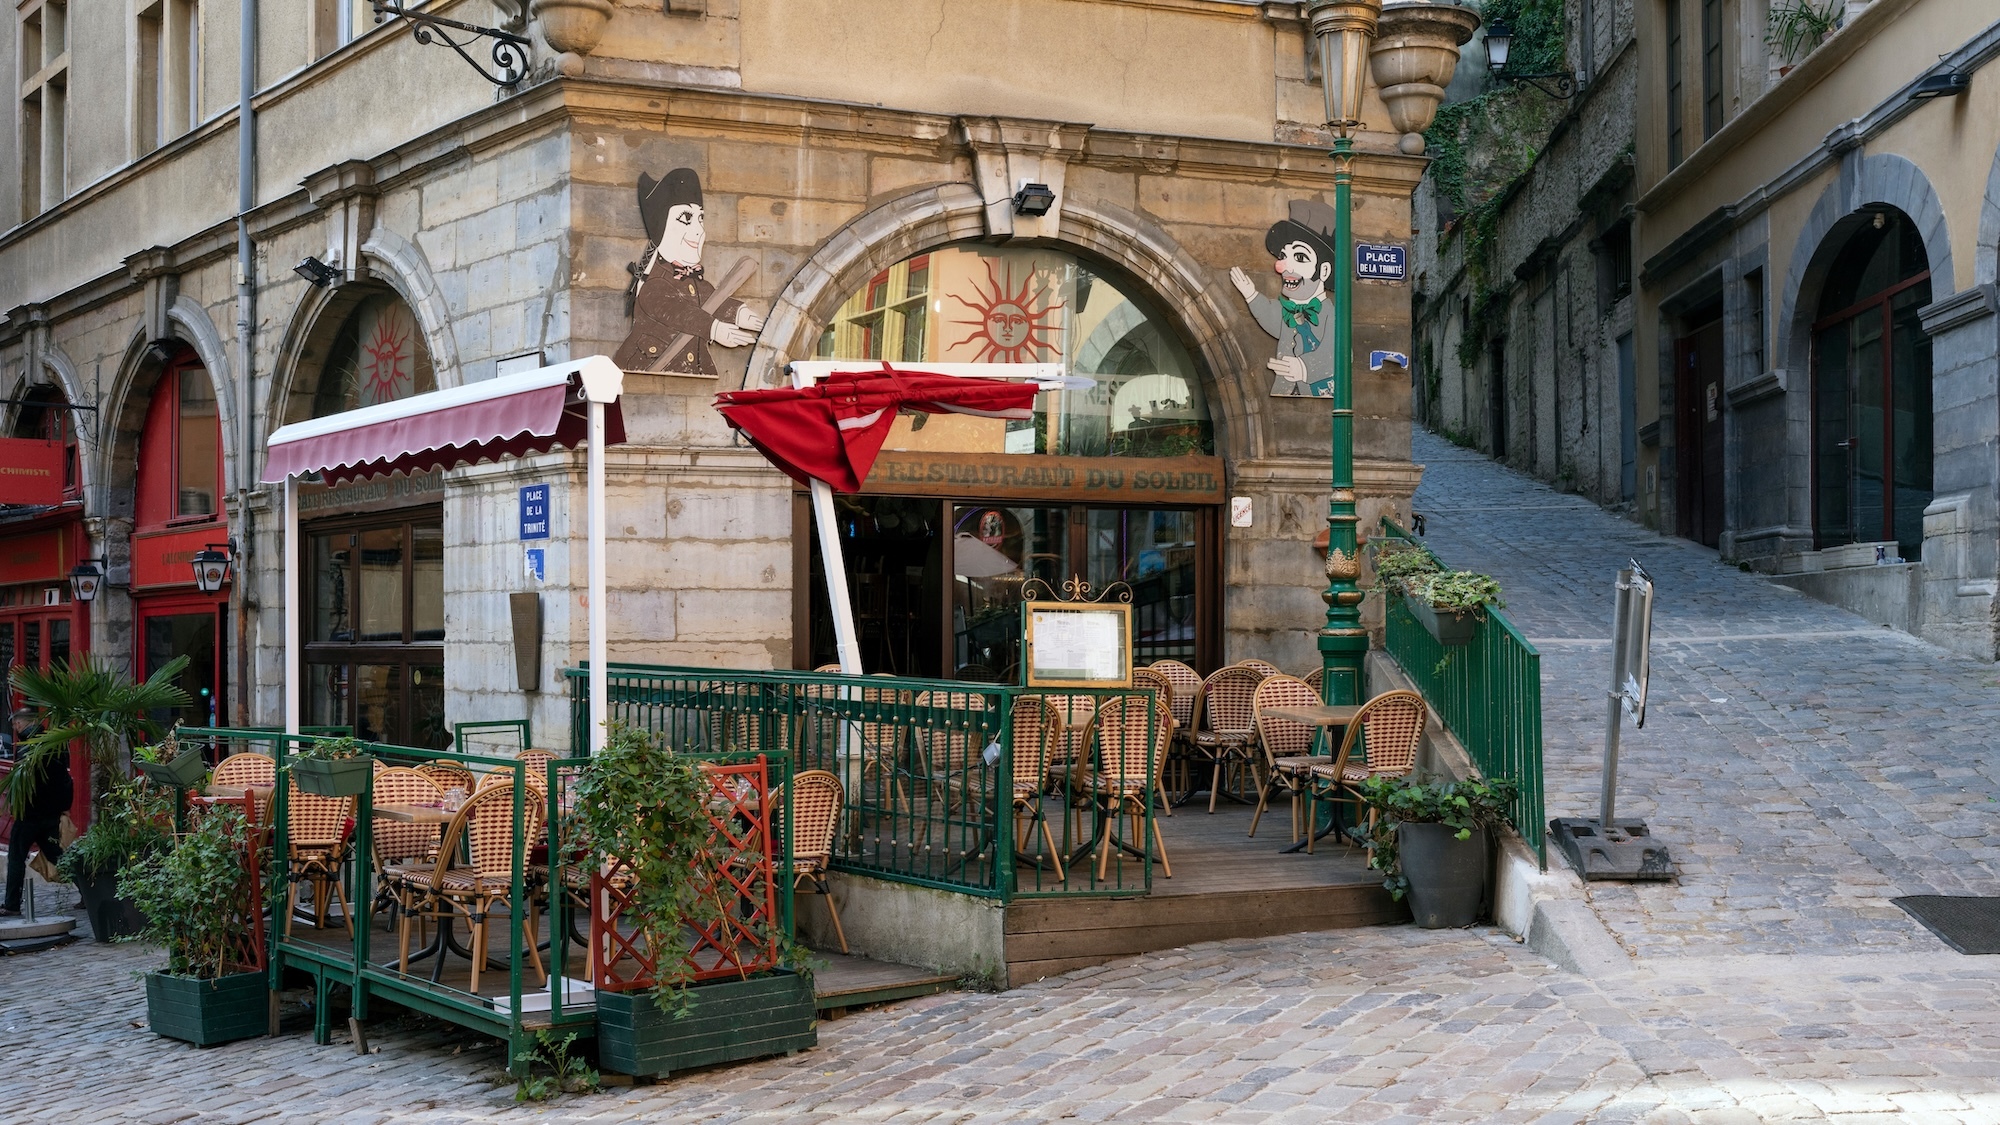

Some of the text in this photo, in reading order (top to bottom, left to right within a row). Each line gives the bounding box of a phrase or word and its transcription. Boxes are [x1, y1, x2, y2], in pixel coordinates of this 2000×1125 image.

[1366, 252, 1397, 262] PLACE
[1360, 263, 1403, 275] DE LA TRINITÉ
[886, 461, 1075, 489] RESTAURANT
[1084, 468, 1125, 491] DU
[1132, 470, 1219, 494] SOLEIL
[320, 482, 388, 509] RESTAURANT
[394, 478, 410, 498] DU
[526, 490, 543, 502] PLACE
[526, 505, 543, 516] DE LA
[523, 519, 546, 534] TRINITÉ
